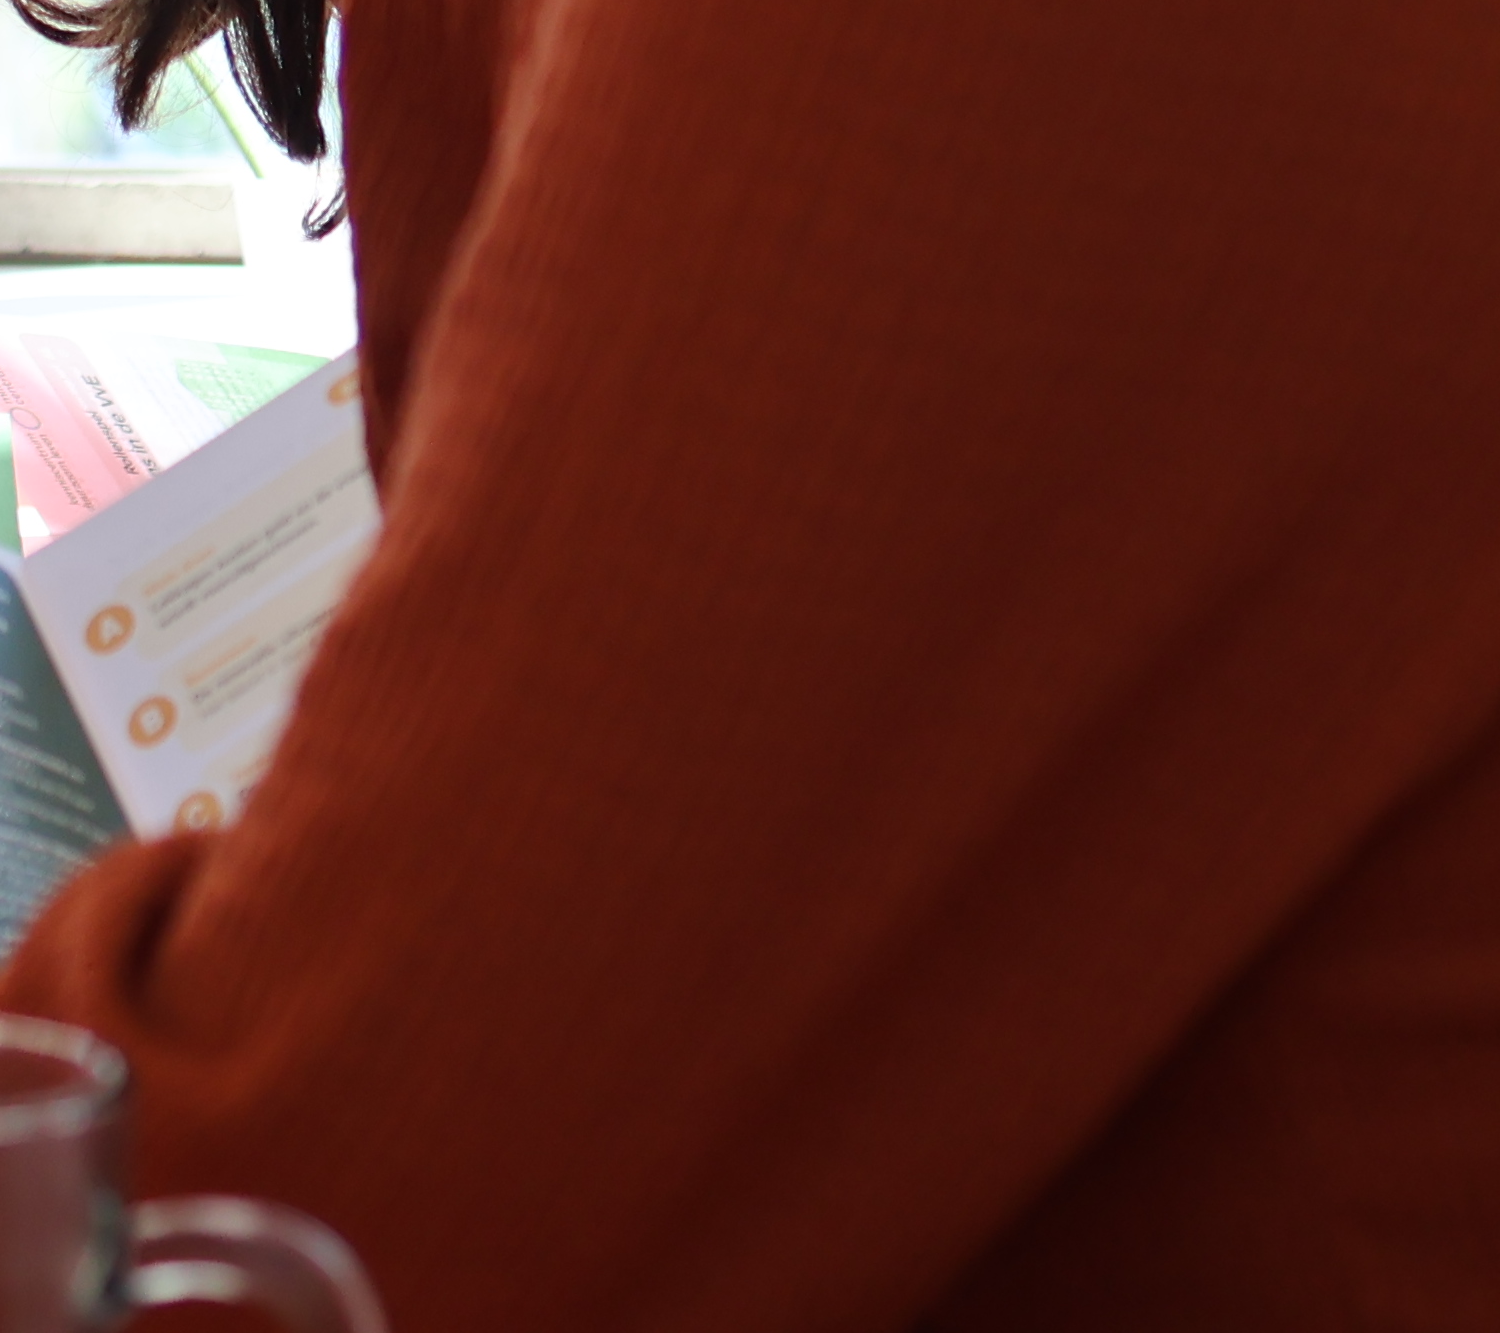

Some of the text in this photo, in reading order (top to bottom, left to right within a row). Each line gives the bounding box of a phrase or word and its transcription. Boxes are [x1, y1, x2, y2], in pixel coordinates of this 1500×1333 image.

[111, 412, 133, 434] de
[86, 411, 139, 475] Rollenspel
[129, 438, 147, 454] in
